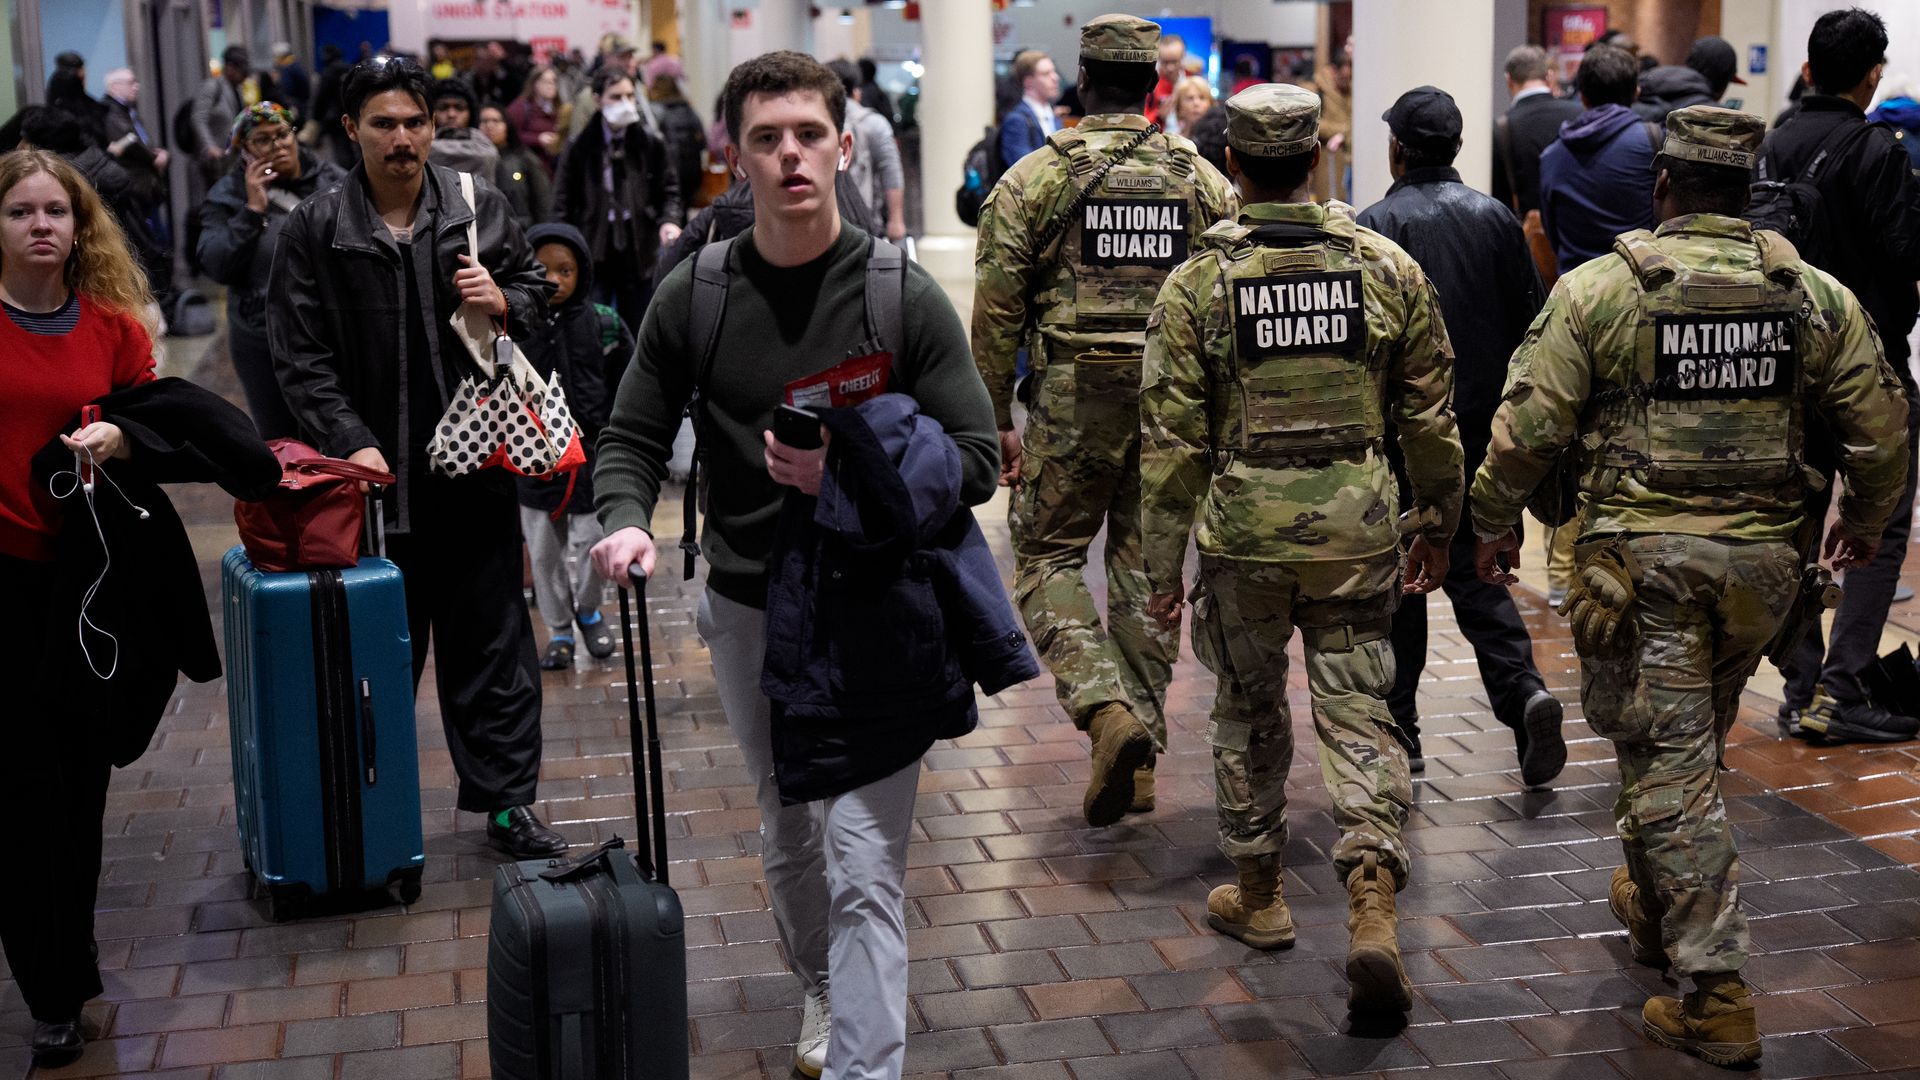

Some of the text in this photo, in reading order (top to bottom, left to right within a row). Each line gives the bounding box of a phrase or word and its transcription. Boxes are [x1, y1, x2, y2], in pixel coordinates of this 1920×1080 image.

[433, 3, 484, 18] UNION
[1112, 50, 1148, 60] WILLIAMS
[1263, 142, 1303, 155] ARCHER
[1116, 178, 1152, 188] WILLIAMS
[1086, 205, 1183, 230] NATIONAL
[1097, 233, 1172, 258] GUARD
[1240, 280, 1359, 315] NATIONAL
[1256, 314, 1348, 348] GUARD
[1663, 321, 1791, 355] NATIONAL
[1677, 357, 1777, 390] GUARD
